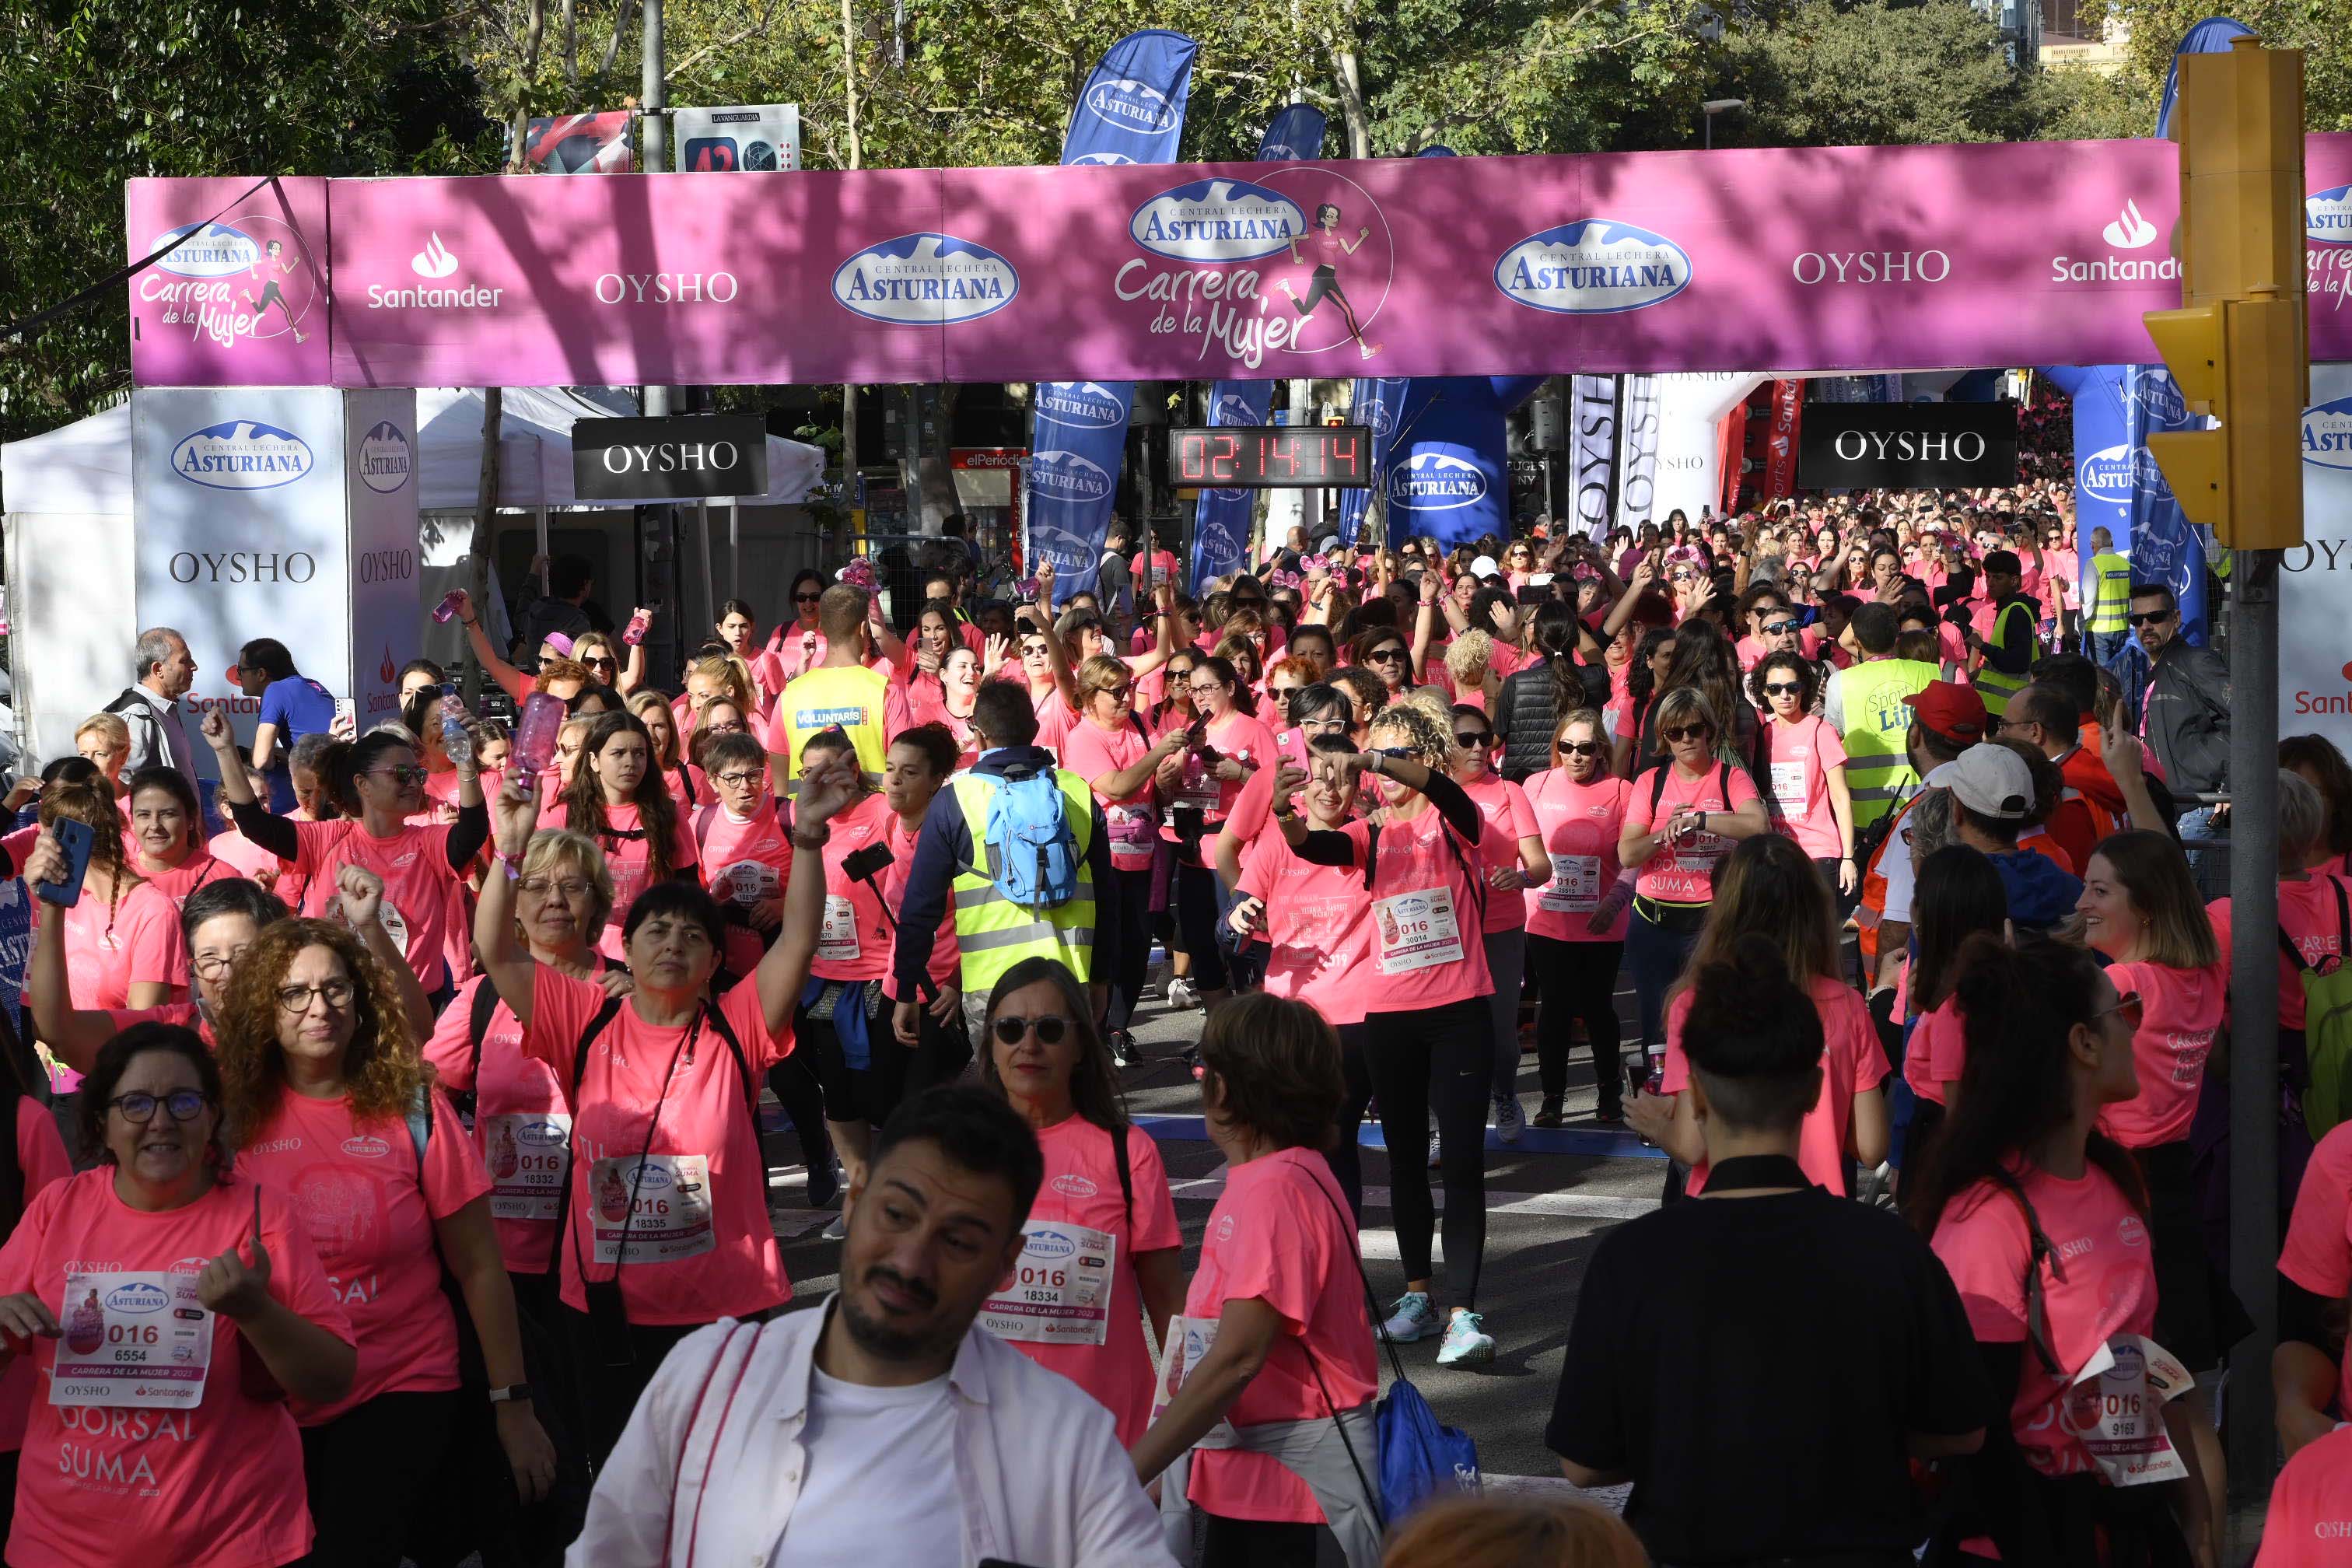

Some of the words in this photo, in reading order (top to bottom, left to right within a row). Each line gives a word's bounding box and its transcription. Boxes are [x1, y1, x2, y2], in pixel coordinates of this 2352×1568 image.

[1093, 89, 1169, 128] ASTURIANA
[1171, 207, 1223, 215] CENTRAL
[1230, 207, 1288, 215] LECHERA
[1143, 209, 1293, 242] ASTURIANA
[158, 243, 251, 264] ASTURIANA
[1540, 254, 1602, 262] CENTRAL
[1605, 251, 1670, 260] LECHERA
[875, 265, 932, 274] CENTRAL
[940, 264, 998, 273] LECHERA
[1509, 255, 1676, 291] ASTURIANA
[1793, 250, 1951, 284] OYSHO
[2052, 257, 2182, 282] Santand
[140, 274, 231, 303] Carrera
[595, 271, 738, 304] OYSHO
[847, 270, 1005, 302] ASTURIANA
[1115, 259, 1259, 302] Carrera
[2325, 271, 2339, 292] la
[368, 284, 503, 309] Santander
[163, 306, 179, 324] de
[183, 304, 195, 324] la
[194, 302, 266, 348] Mujer
[1151, 306, 1179, 334] de
[1184, 303, 1202, 334] la
[1199, 290, 1314, 369] Mujer
[1035, 391, 1116, 422] ASTURIANA
[1835, 430, 1985, 462] OYSHO
[183, 446, 303, 473] ASTURIANA
[363, 448, 408, 476] ASTURIANA
[604, 441, 738, 474] OYSHO
[1181, 436, 1356, 479] 02:14:14
[1657, 456, 1703, 470] YSHO
[1030, 470, 1104, 495] STURIANA
[1392, 475, 1479, 498] ASTURIANA
[361, 548, 412, 583] OYSHO
[2280, 539, 2352, 573] OY
[170, 551, 316, 583] OYSHO
[1868, 684, 1909, 712] Sport
[798, 711, 860, 724] VOLUNTARIS
[1878, 703, 1915, 733] Lif
[736, 883, 757, 892] 016
[1557, 877, 1578, 887] 016
[1650, 876, 1695, 893] SUMA
[1397, 905, 1426, 915] ASTURIANA
[1401, 920, 1429, 935] 016
[1405, 934, 1427, 944] 30014
[1390, 957, 1412, 968] OYSHO
[520, 1130, 563, 1141] ASTURIANA
[254, 1137, 302, 1156] OYSHO
[345, 1143, 387, 1153] ASTURIANA
[520, 1155, 559, 1170] 016
[524, 1174, 554, 1184] 18332
[1055, 1181, 1097, 1194] ASTURIANA
[633, 1199, 670, 1214] 016
[635, 1219, 667, 1228] 18335
[605, 1246, 640, 1256] OYHO
[2053, 1237, 2094, 1262] YSHO
[64, 1260, 122, 1275] OYSHO
[1020, 1267, 1067, 1286] 016
[110, 1295, 163, 1307] ASTURIANA
[1024, 1290, 1059, 1302] 18334
[989, 1303, 1024, 1312] CARRERA
[108, 1325, 159, 1344] 016
[986, 1318, 1024, 1332] OYSHO
[1056, 1325, 1096, 1334] Santander
[114, 1350, 147, 1362] 6554
[65, 1385, 110, 1397] OYSHO
[148, 1387, 194, 1398] Santander
[2107, 1394, 2140, 1415] 016
[58, 1405, 196, 1441] DORSAL
[2112, 1422, 2135, 1435] 9169
[59, 1443, 156, 1485] SUMA
